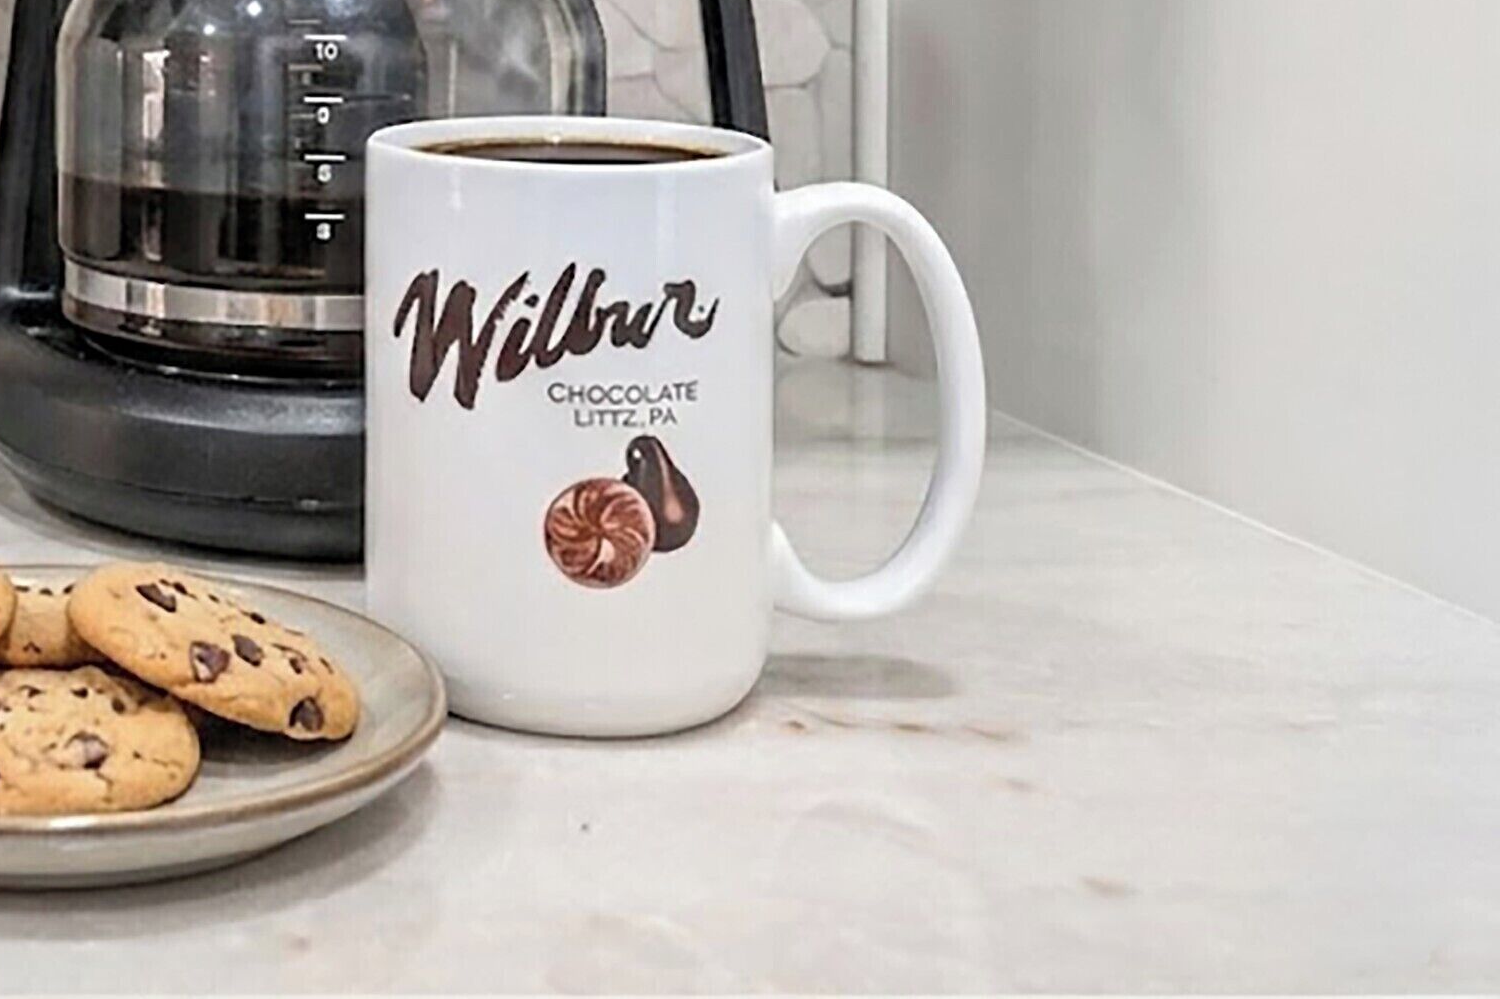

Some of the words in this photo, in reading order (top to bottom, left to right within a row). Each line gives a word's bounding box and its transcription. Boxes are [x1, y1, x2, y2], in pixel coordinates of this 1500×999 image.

[315, 42, 338, 61] 10
[394, 262, 719, 410] Wilbur
[547, 380, 699, 405] CHOCOLATE
[649, 406, 678, 426] PA
